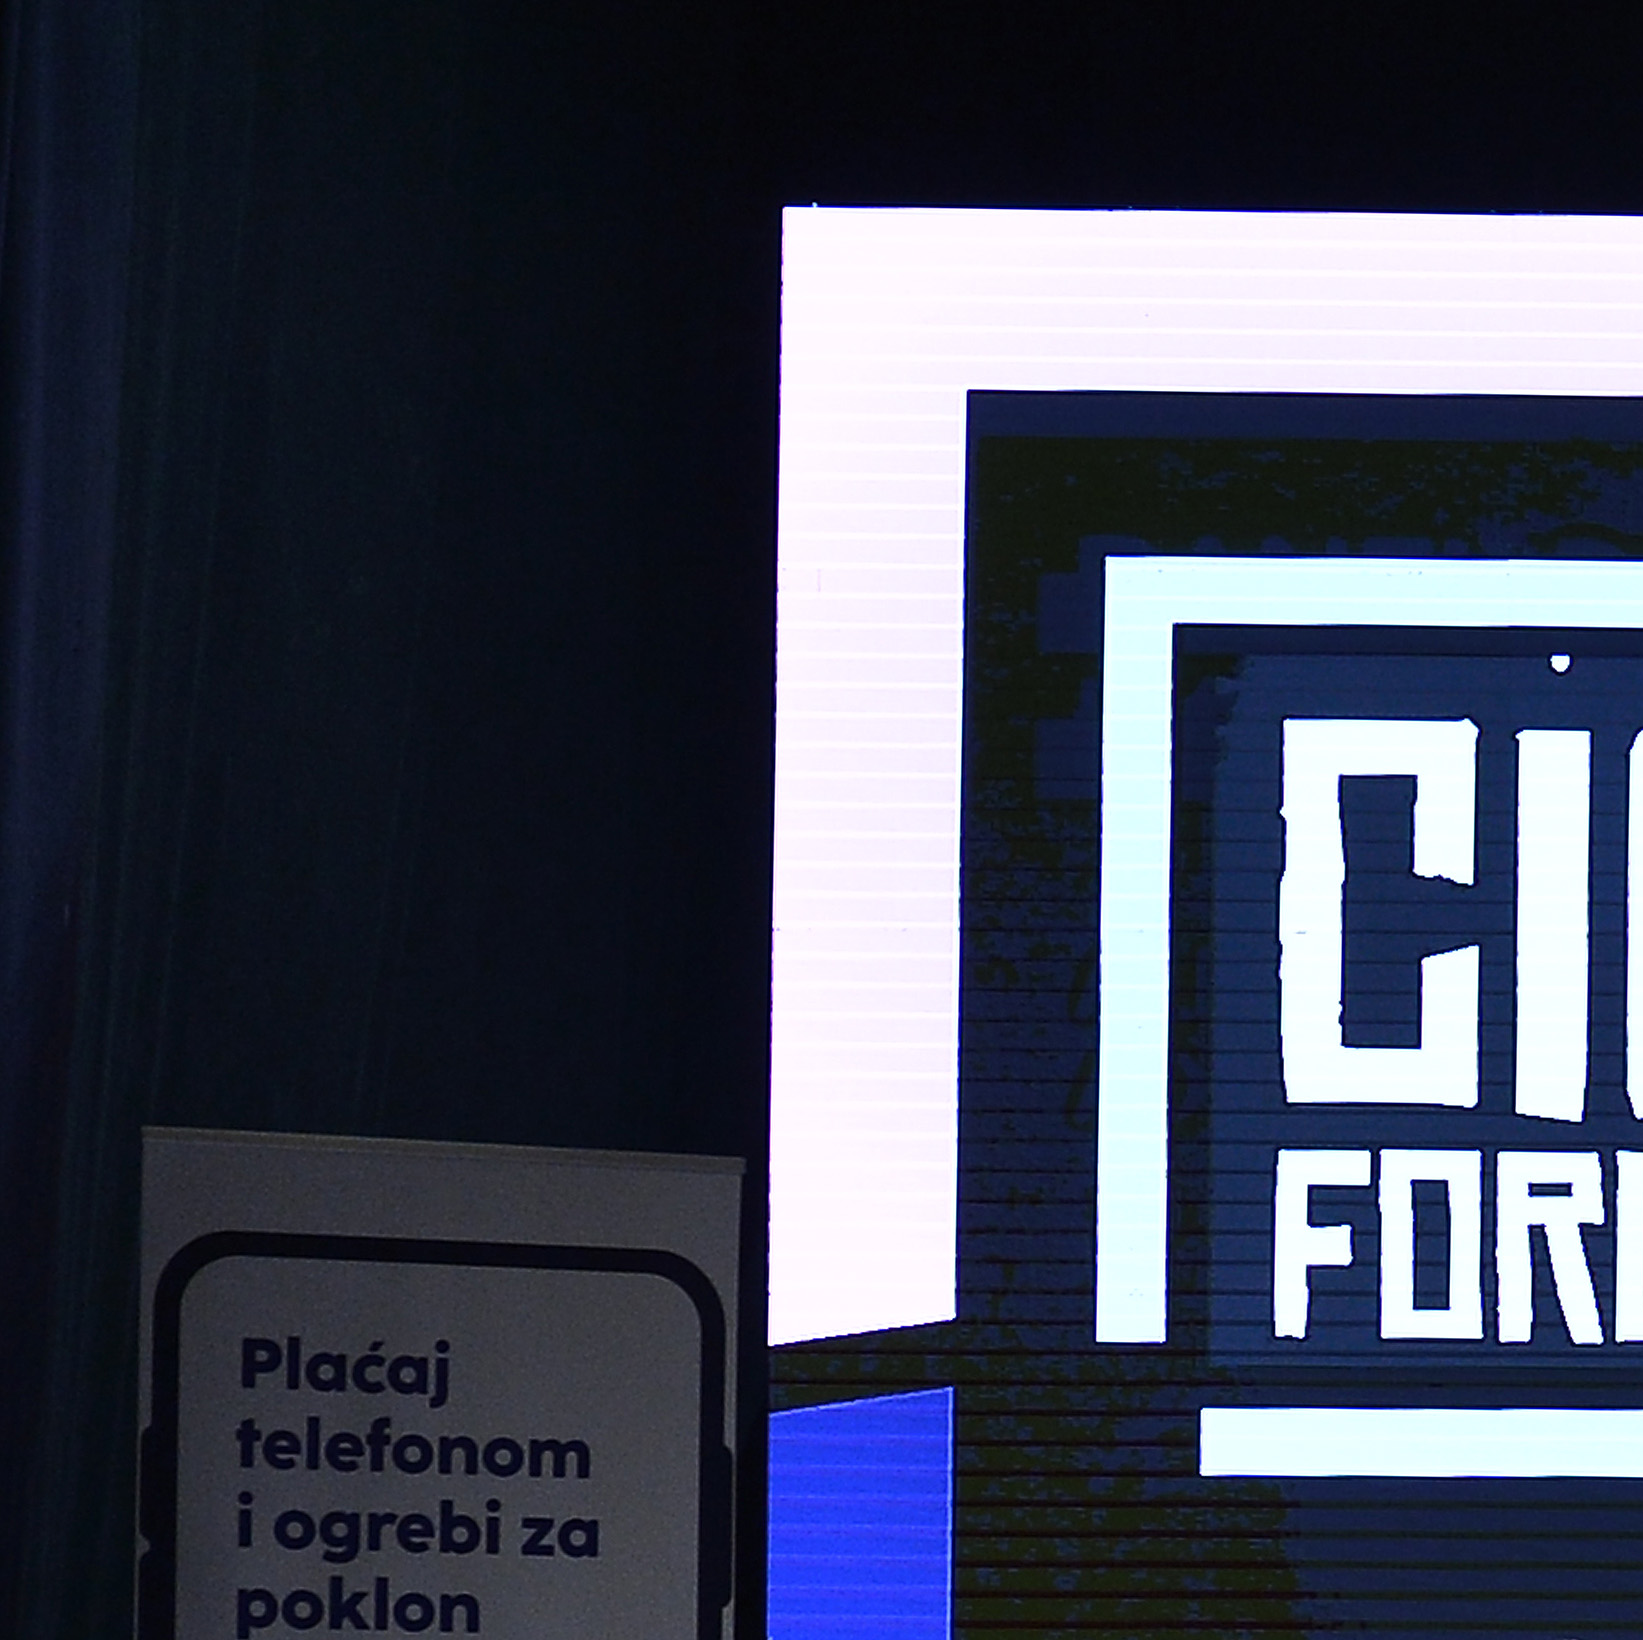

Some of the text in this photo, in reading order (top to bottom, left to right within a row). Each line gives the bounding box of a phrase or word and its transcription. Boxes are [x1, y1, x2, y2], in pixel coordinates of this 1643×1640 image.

[242, 1336, 450, 1408] Plaćaj
[235, 1416, 590, 1478] telefonom
[238, 1491, 599, 1563] i ogrebi za
[237, 1576, 479, 1640] poklon
